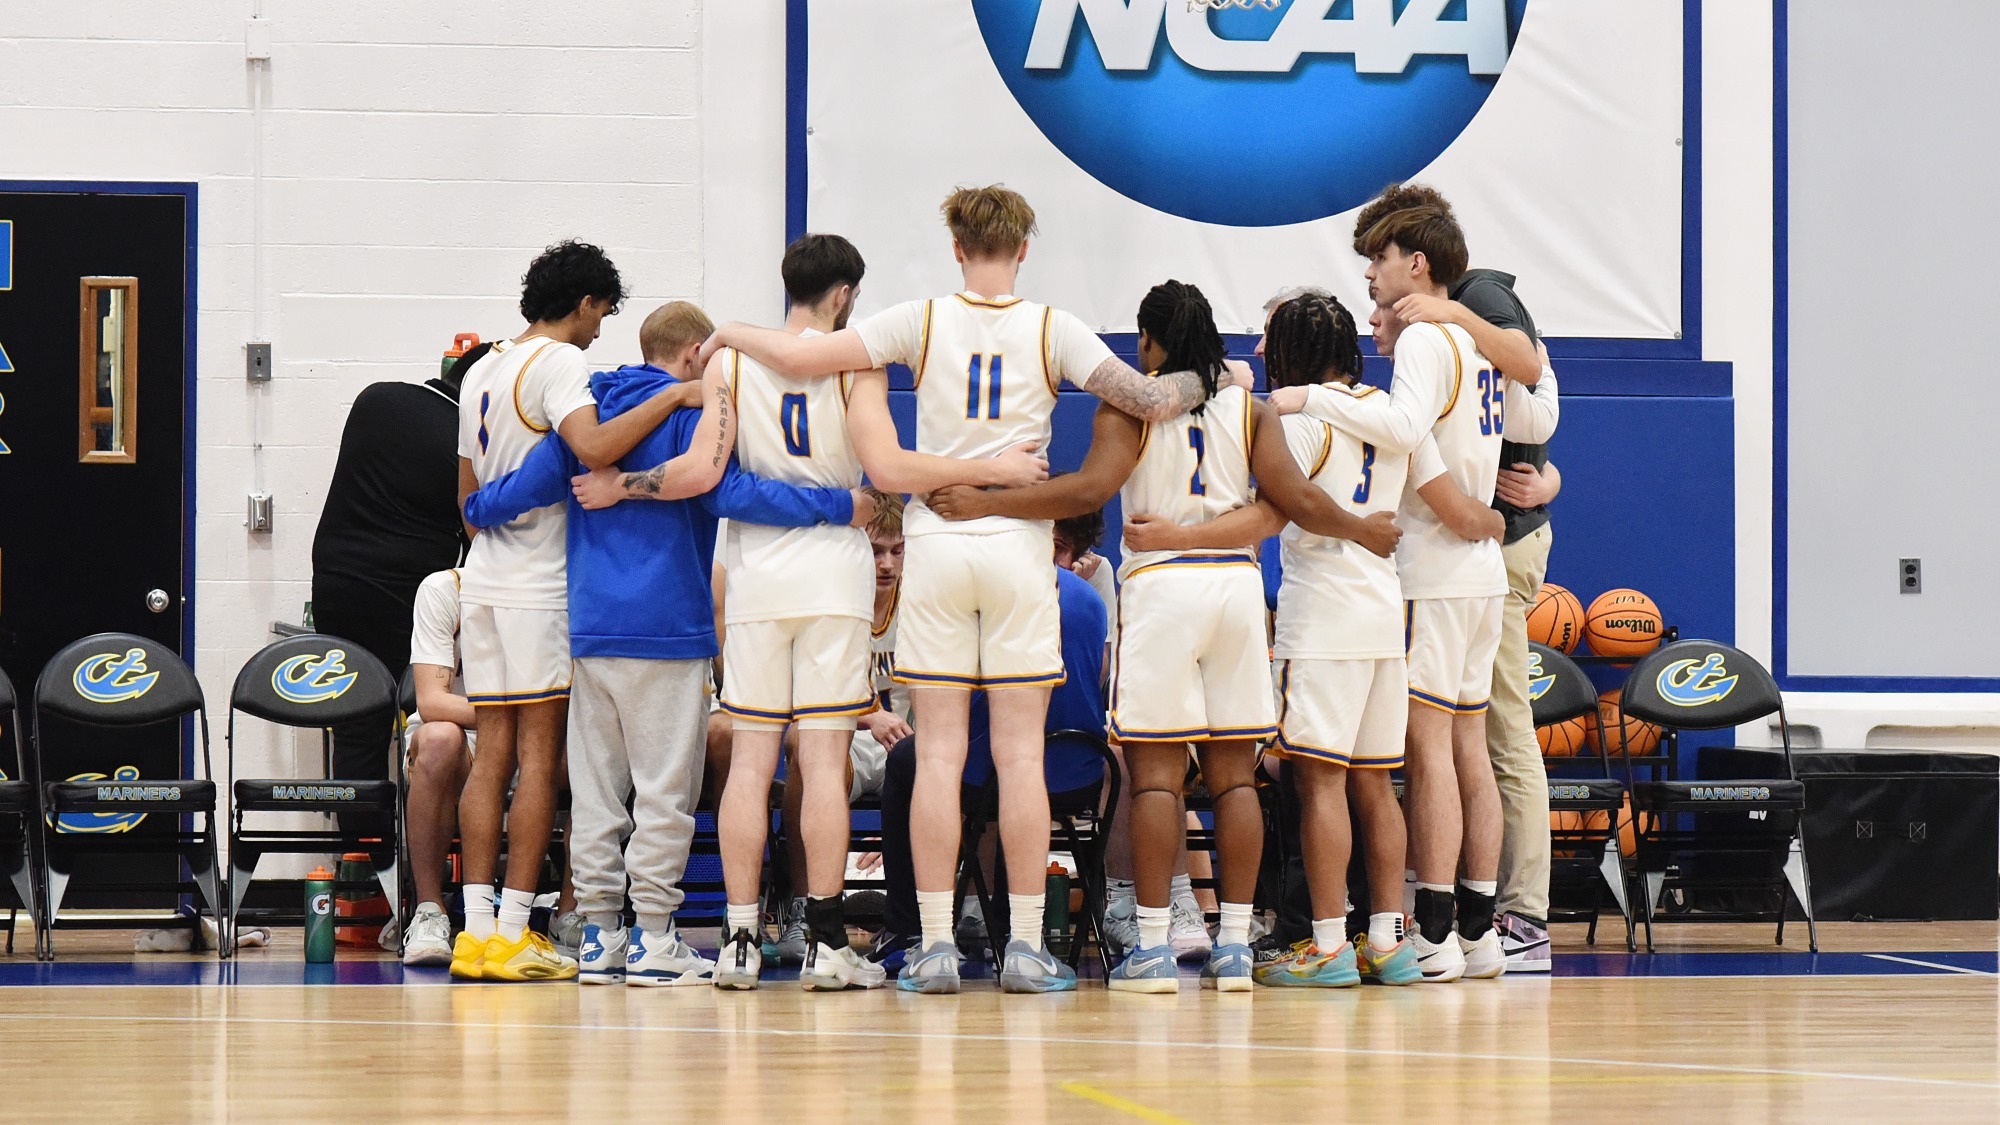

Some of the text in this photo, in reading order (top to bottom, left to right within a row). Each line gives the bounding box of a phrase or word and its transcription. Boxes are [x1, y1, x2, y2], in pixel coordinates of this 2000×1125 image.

[1024, 0, 1508, 75] NCAA
[965, 352, 1004, 420] 11
[1477, 367, 1505, 437] 35
[779, 390, 812, 458] 0
[1188, 424, 1207, 497] 2
[1352, 440, 1377, 505] 3
[1605, 619, 1656, 634] Wilson
[97, 786, 181, 800] MARINERS
[272, 786, 356, 800] MARINERS
[1690, 787, 1770, 800] MARINERS
[312, 894, 330, 915] G
